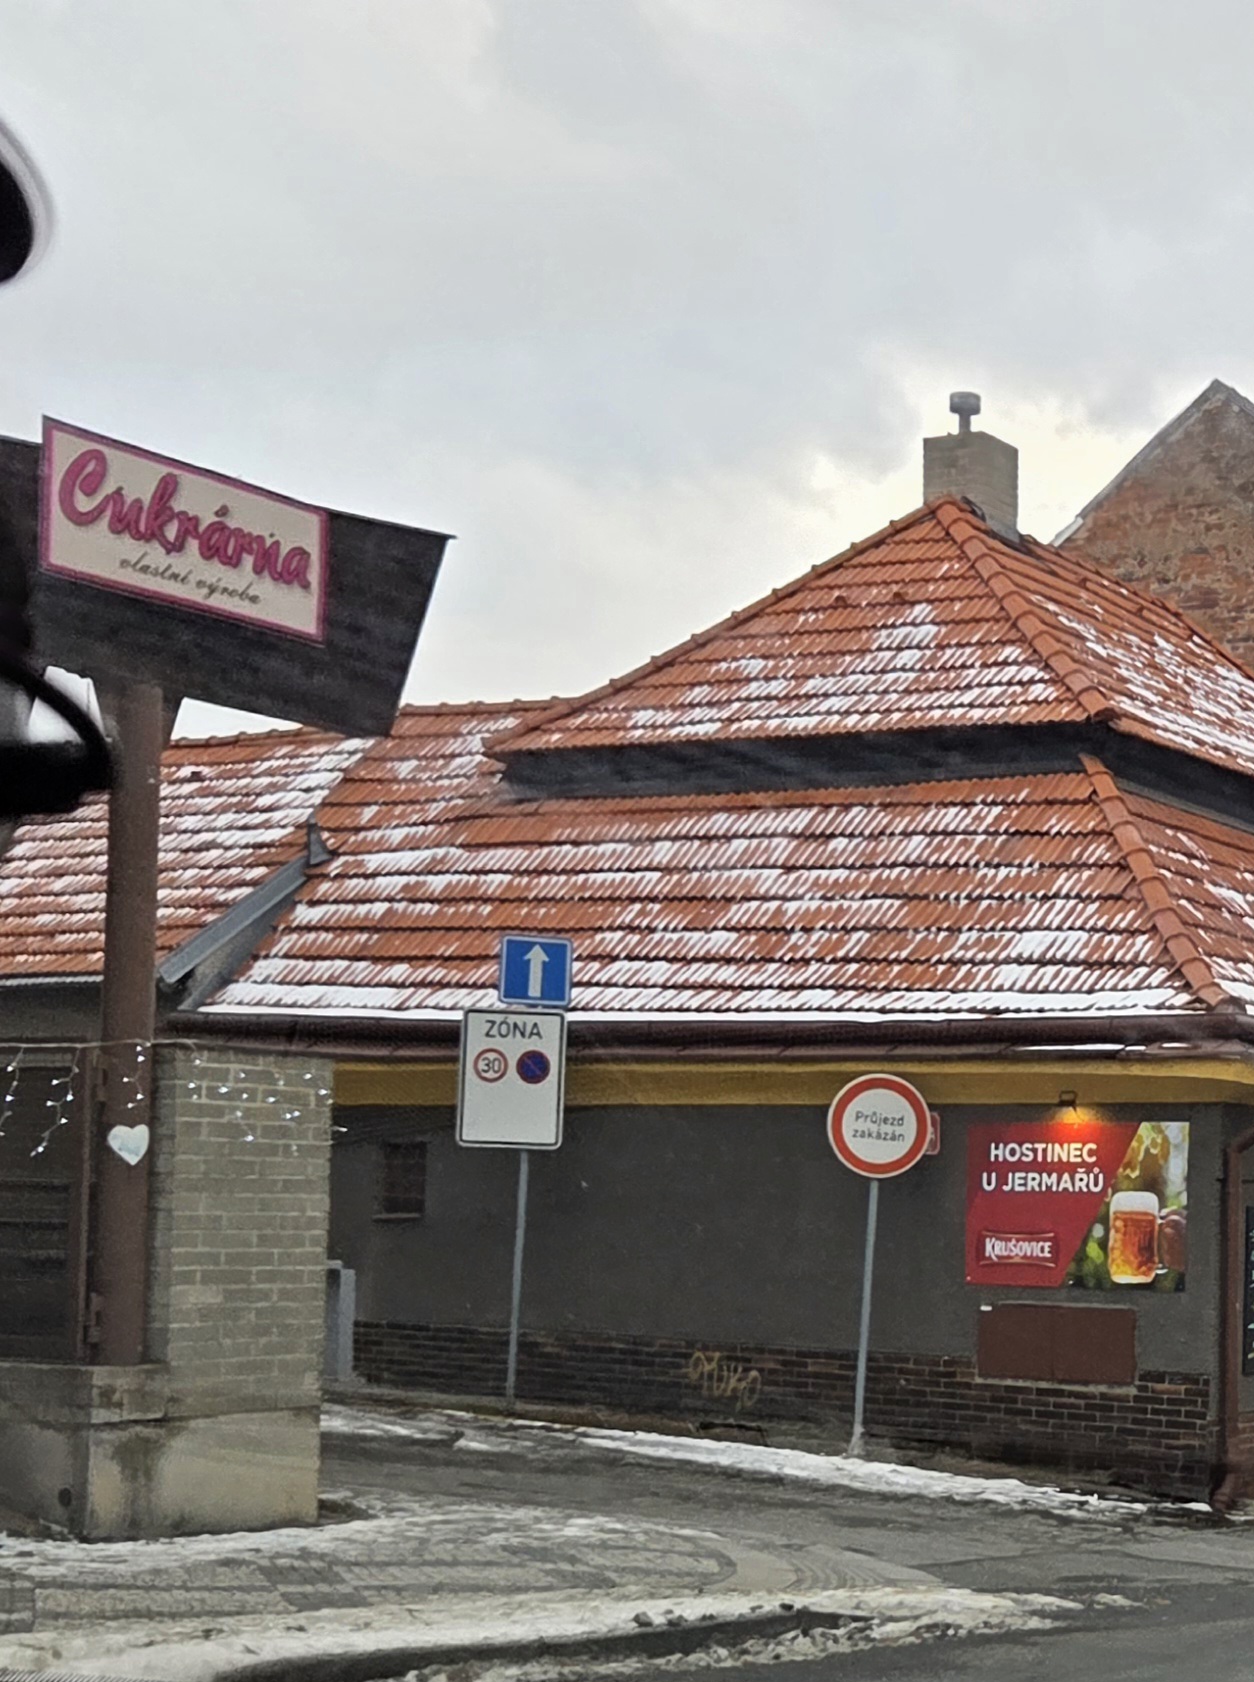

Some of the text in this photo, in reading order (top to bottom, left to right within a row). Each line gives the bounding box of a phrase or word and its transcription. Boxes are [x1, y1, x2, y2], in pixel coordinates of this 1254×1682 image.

[59, 449, 311, 589] Cukrárna
[119, 551, 262, 604] vlastní výroba
[484, 1016, 543, 1039] ZÓNA
[481, 1056, 502, 1074] 30
[854, 1110, 905, 1127] Průjezd
[851, 1128, 905, 1142] zakázán
[990, 1143, 1097, 1162] HOSTINEC
[982, 1167, 1104, 1192] U JERMAŘŮ
